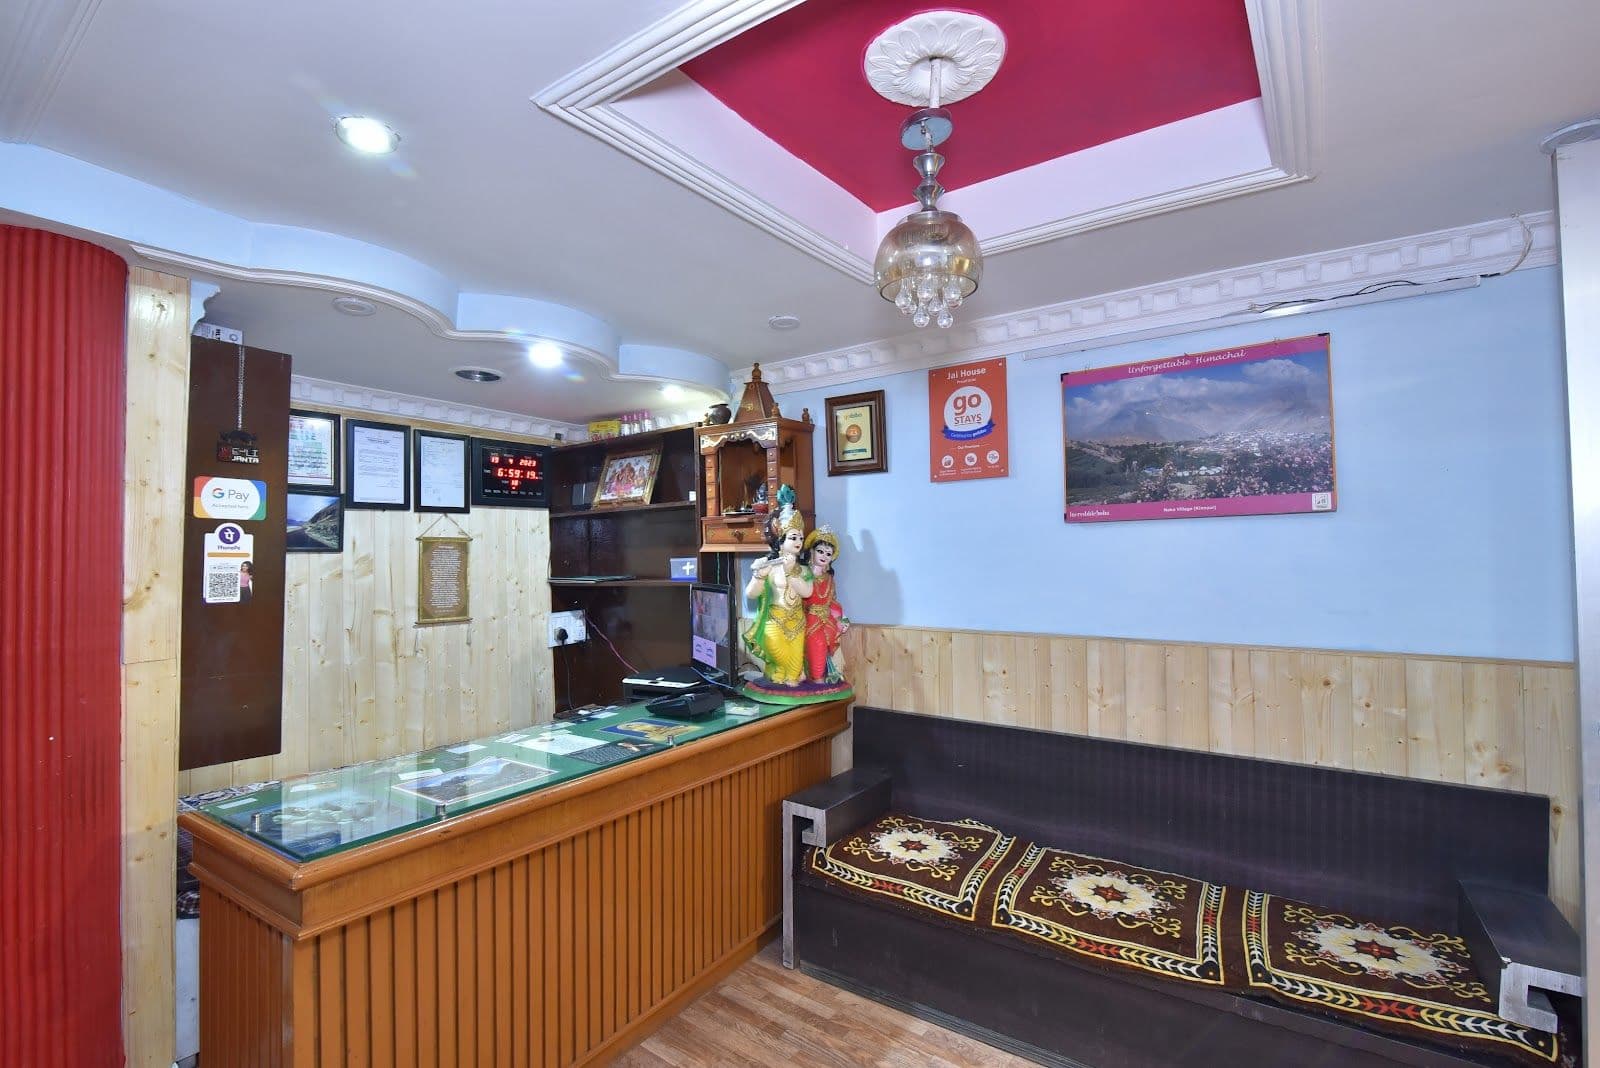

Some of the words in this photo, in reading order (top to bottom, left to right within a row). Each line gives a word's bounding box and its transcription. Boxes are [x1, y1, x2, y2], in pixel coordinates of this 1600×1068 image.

[1128, 359, 1191, 374] Unforgettable
[1195, 349, 1247, 364] Himachal
[960, 368, 986, 378] House
[953, 394, 982, 416] go
[954, 414, 982, 425] STAYS
[231, 455, 260, 463] JANTA
[228, 489, 250, 503] Pay
